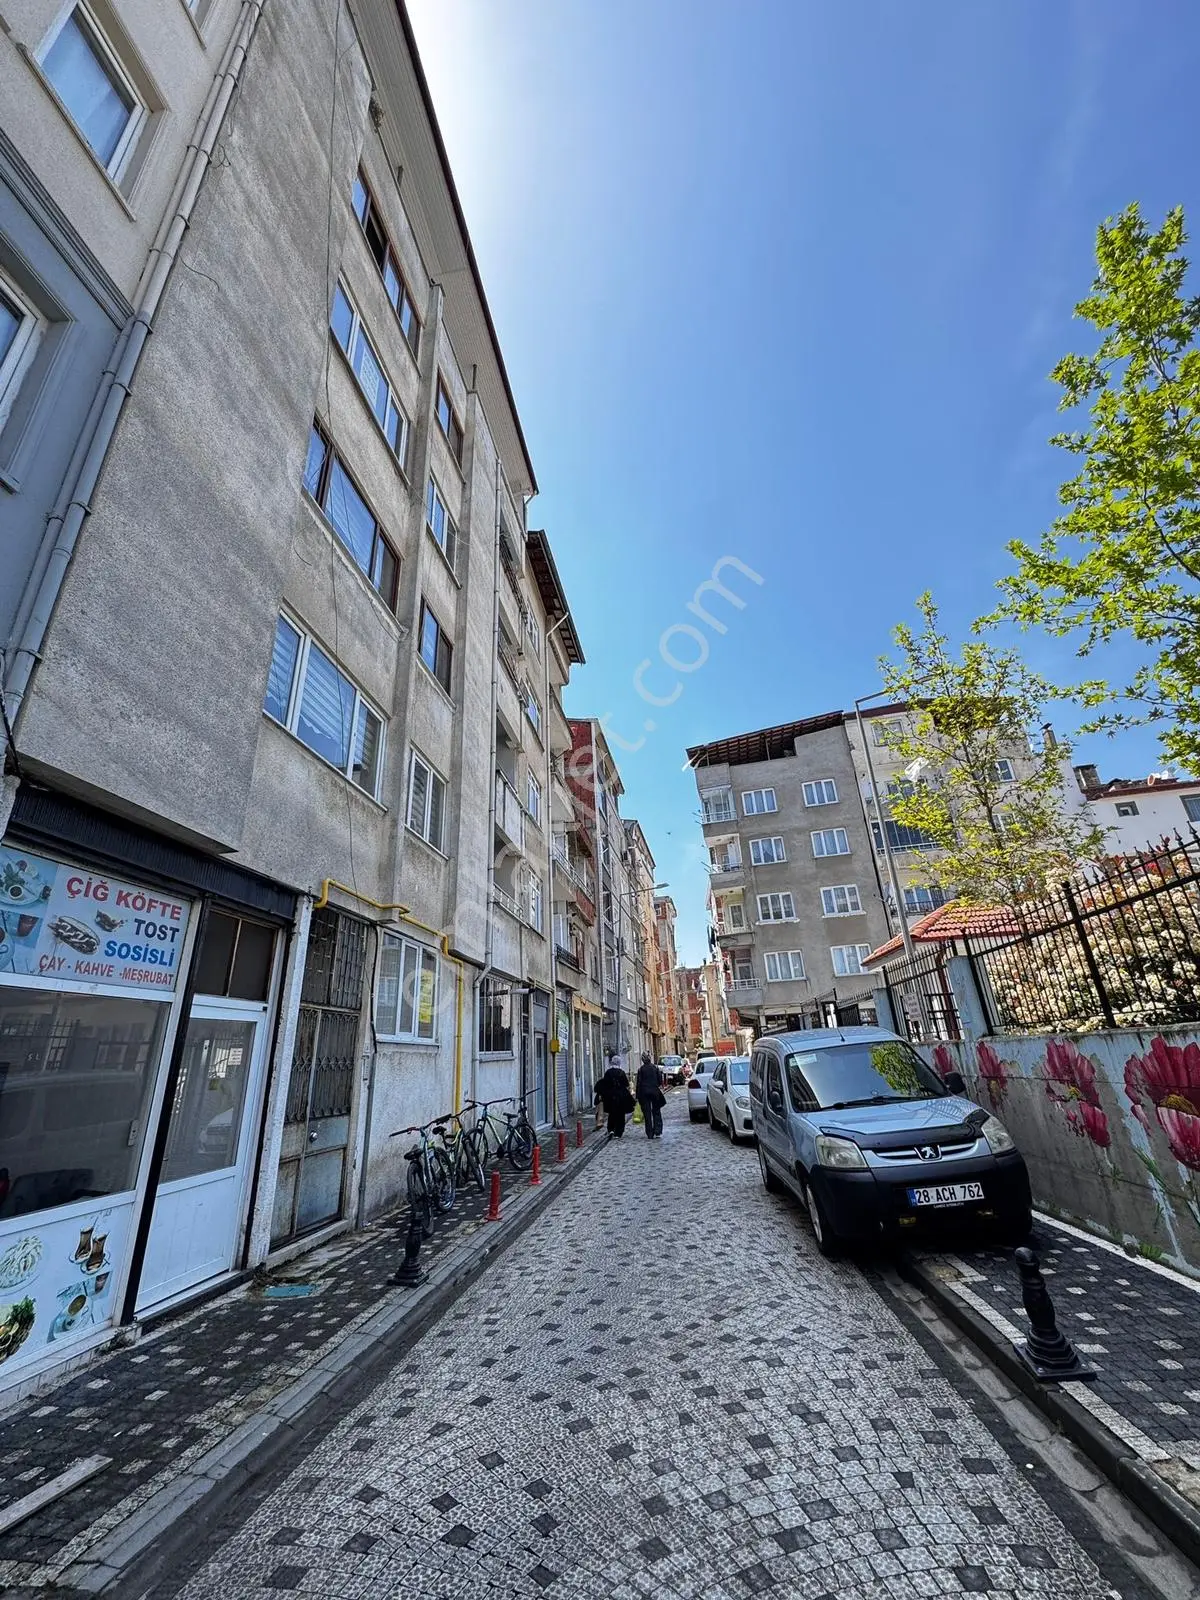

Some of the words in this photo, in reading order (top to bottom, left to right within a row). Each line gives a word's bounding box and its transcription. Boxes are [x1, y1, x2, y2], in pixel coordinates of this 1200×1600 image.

[66, 877, 109, 902] ÇİĞ
[116, 889, 182, 921] KÖFTE
[134, 918, 179, 943] TOST
[39, 954, 66, 973] ÇAY
[74, 960, 114, 977] KAHVE
[104, 940, 175, 967] SOSİSLİ
[915, 1189, 931, 1204] 28
[935, 1187, 957, 1202] ACH
[960, 1184, 983, 1199] 762
